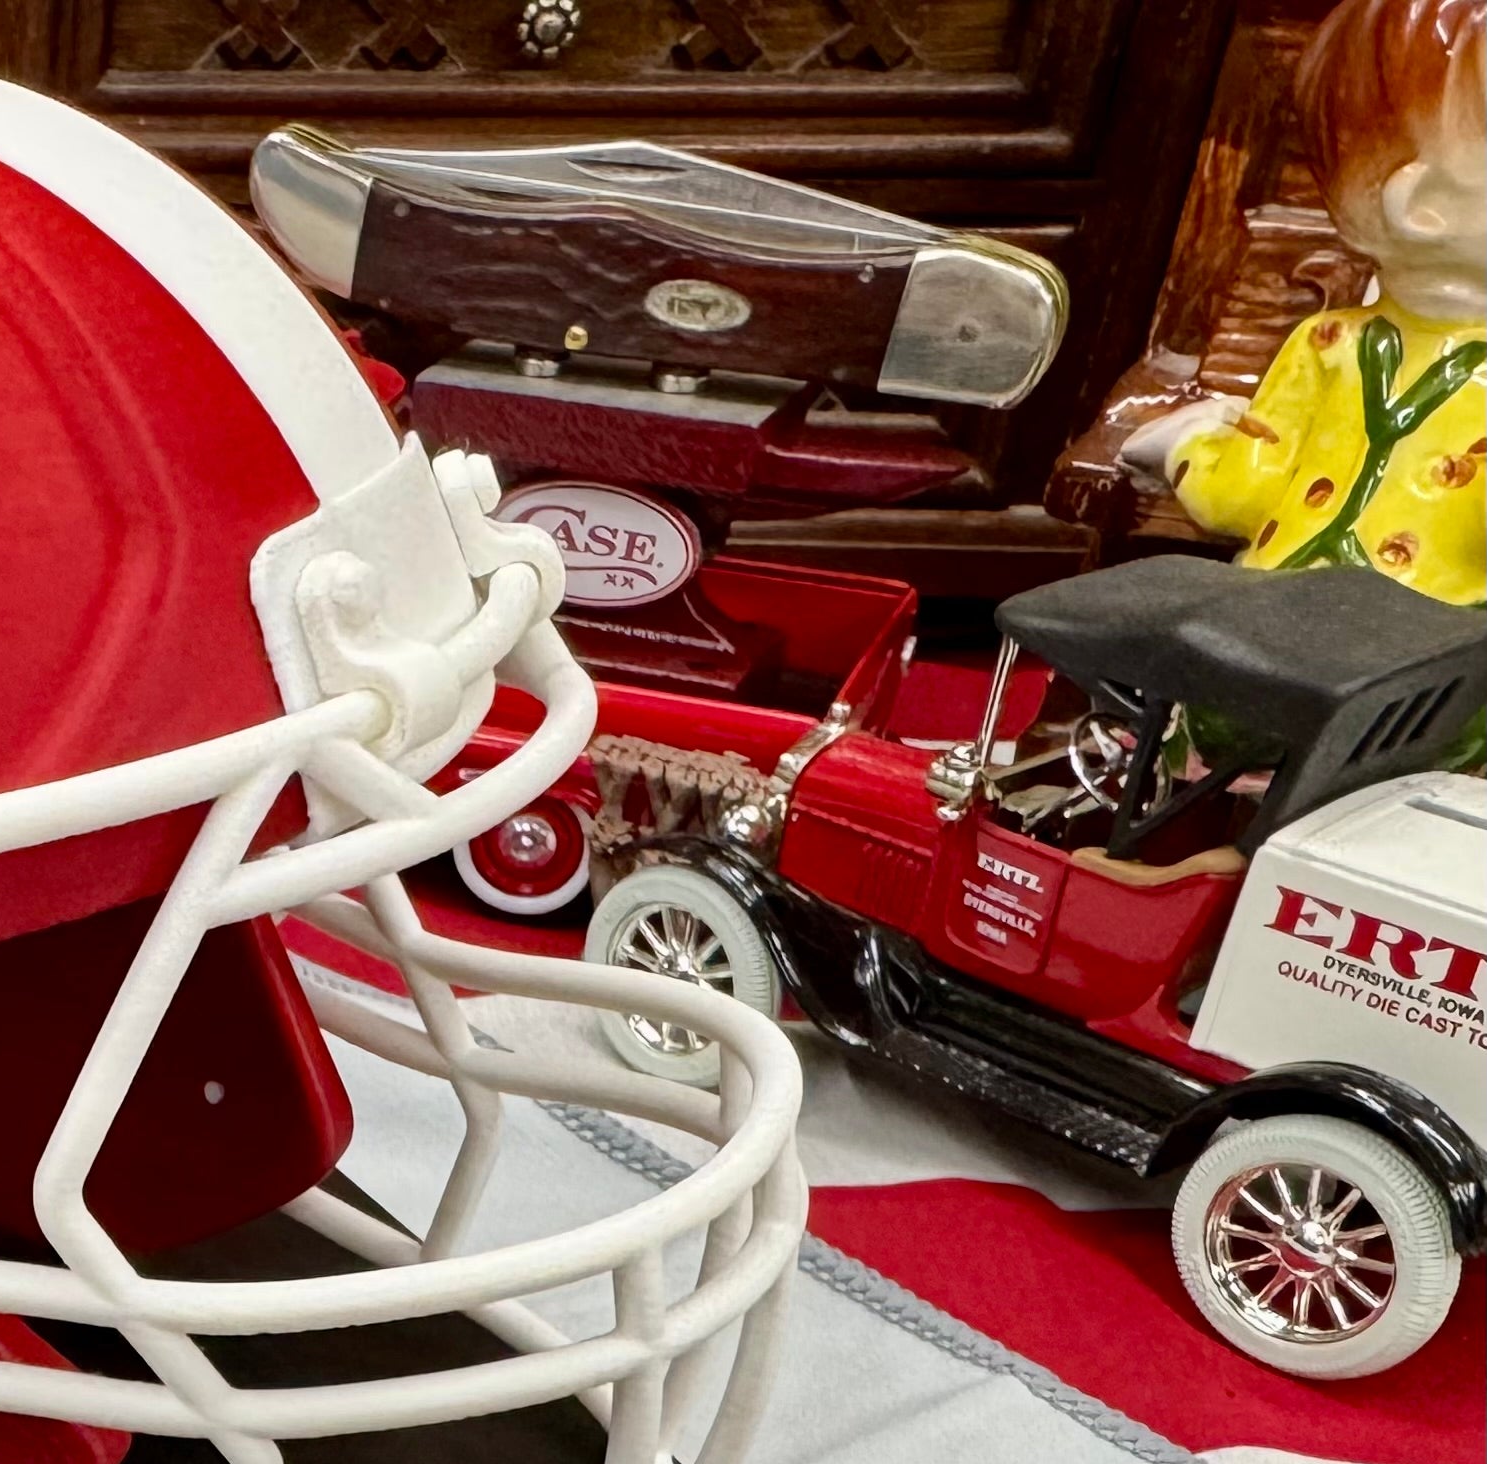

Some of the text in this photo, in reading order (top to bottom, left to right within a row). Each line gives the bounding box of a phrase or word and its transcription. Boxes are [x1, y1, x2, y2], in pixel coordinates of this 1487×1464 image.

[1278, 961, 1363, 1002] QUALITY
[1366, 992, 1401, 1017] DIE
[1405, 1007, 1462, 1038] CAST
[1323, 955, 1485, 1025] DYERSVILLE, IOWA
